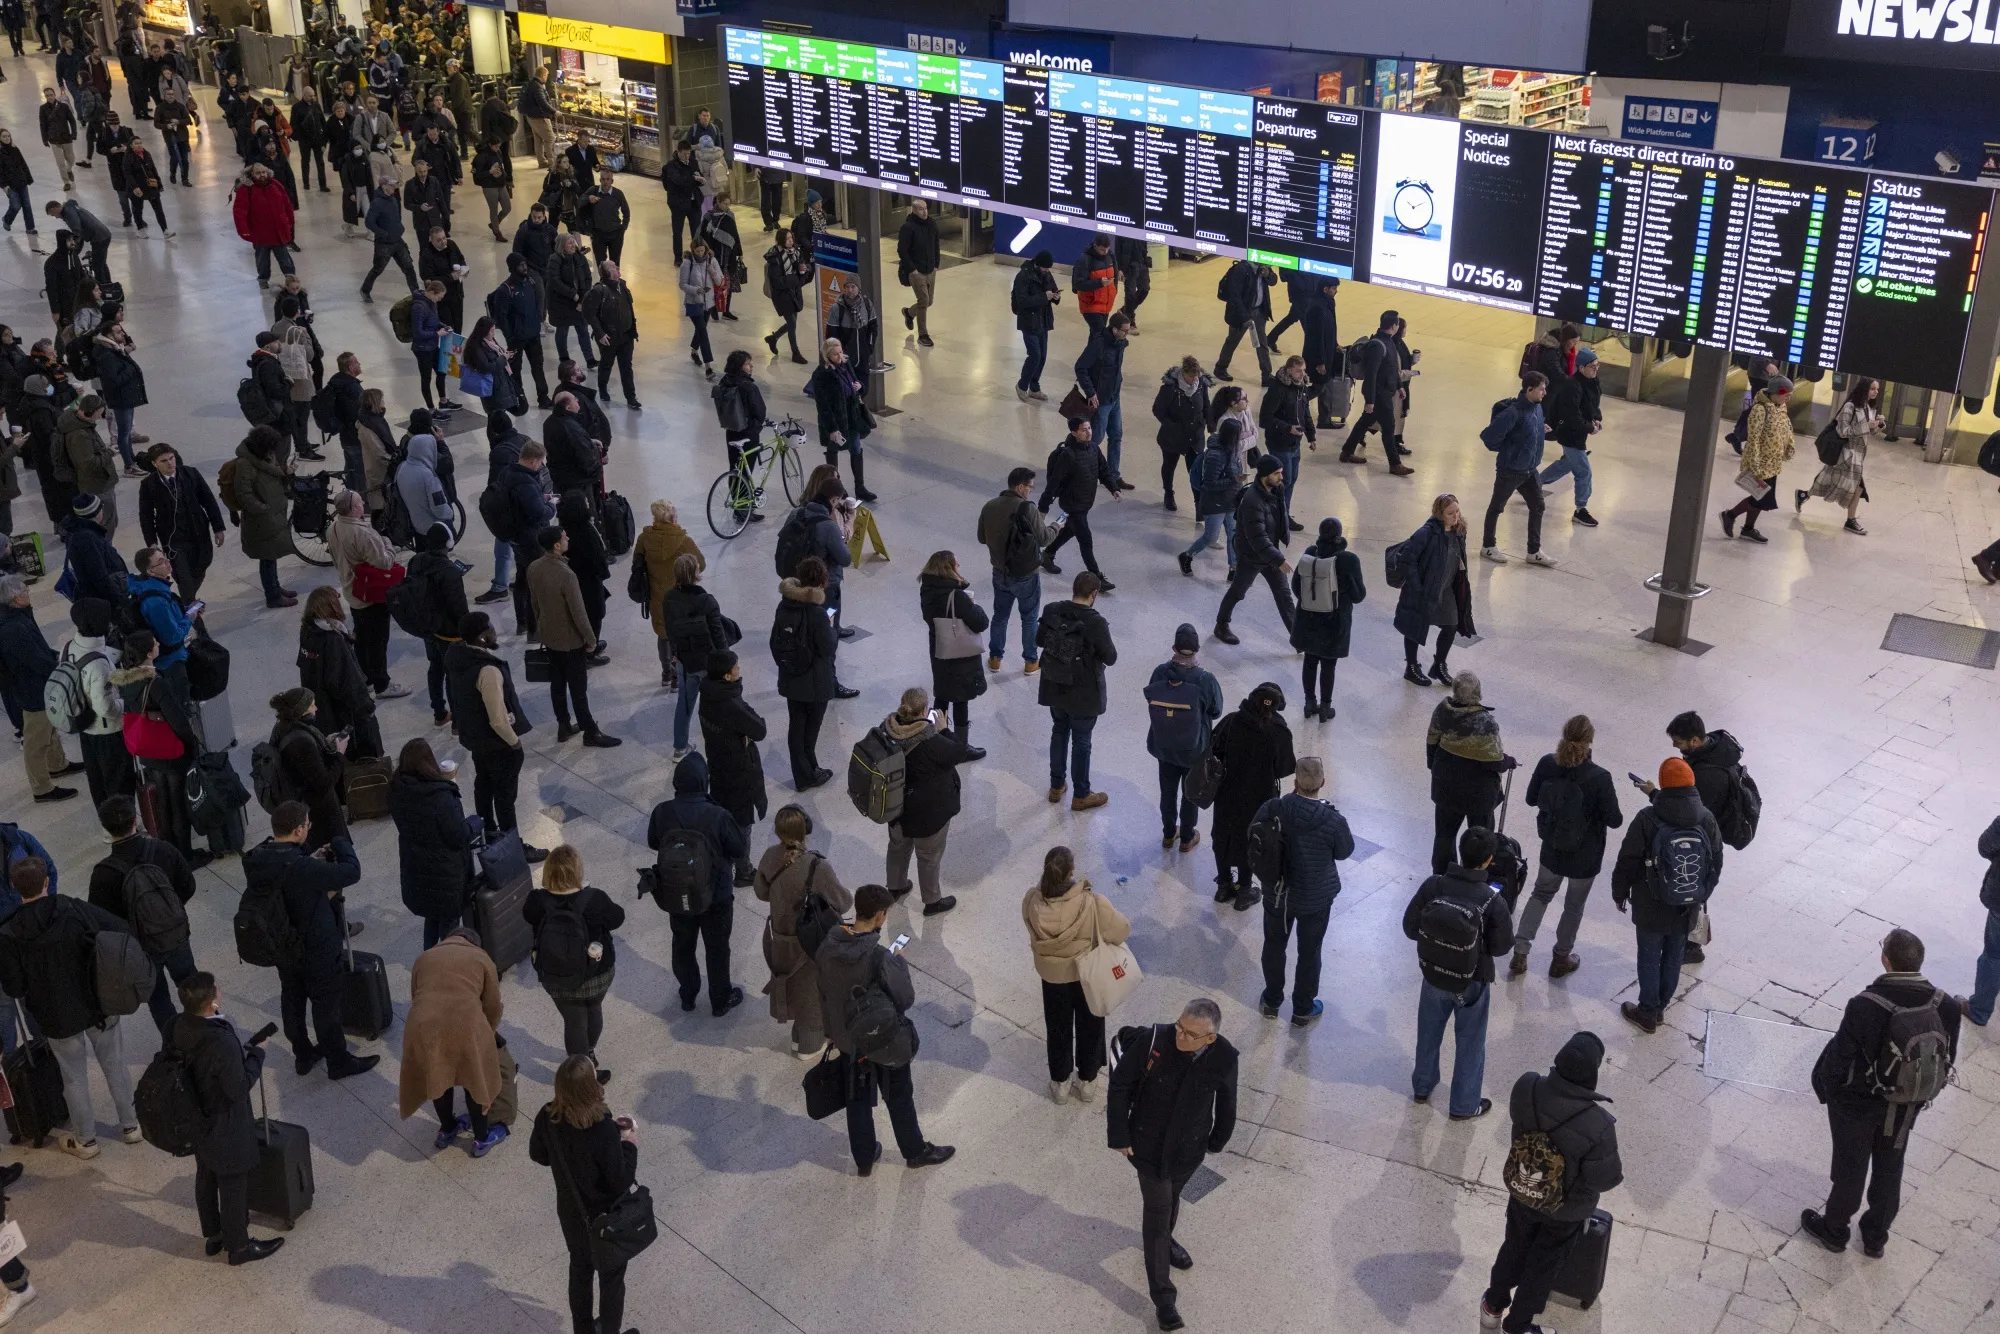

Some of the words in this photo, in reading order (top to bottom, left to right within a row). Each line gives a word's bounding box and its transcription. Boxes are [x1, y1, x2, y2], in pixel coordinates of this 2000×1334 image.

[1837, 0, 2000, 44] NEWSL
[546, 19, 570, 42] Upper
[569, 26, 593, 42] Crust
[1010, 49, 1093, 72] welcome
[1026, 70, 1048, 78] Cancelled
[1099, 89, 1132, 101] Strawberry
[1257, 102, 1297, 118] Further
[1257, 120, 1316, 139] Departures
[1628, 126, 1645, 134] Wide
[1646, 128, 1674, 137] Platform
[1465, 130, 1509, 147] Special
[1822, 136, 1858, 161] 12
[1864, 133, 1876, 160] 12
[1464, 148, 1510, 166] Notices
[1554, 152, 1581, 160] Destination
[1555, 136, 1587, 152] Next
[1589, 140, 1635, 158] fastest
[1638, 146, 1678, 164] direct
[1682, 153, 1715, 168] train
[1719, 157, 1734, 170] to
[1553, 160, 1576, 168] Aldershot
[1653, 165, 1682, 174] Destination
[1652, 173, 1679, 183] Godalming
[1758, 179, 1790, 188] Destination
[1872, 179, 1921, 198] Status
[1650, 190, 1673, 198] Hampton
[1758, 187, 1791, 197] Southamptn
[1756, 196, 1792, 205] Southampton
[1549, 208, 1570, 216] Bracknell
[1761, 205, 1789, 214] Margarets
[1890, 201, 1925, 212] Suburban
[1926, 206, 1946, 214] Lines
[1889, 210, 1909, 219] Major
[1909, 213, 1944, 223] Disruption
[1547, 224, 1568, 233] Clapham
[1887, 222, 1908, 230] South
[1909, 224, 1939, 234] Western
[1940, 229, 1972, 239] Mainline
[1886, 230, 1905, 239] Major
[1906, 233, 1940, 244] Disruption
[1644, 239, 1665, 247] Kingston
[1750, 238, 1780, 247] Teddington
[824, 242, 852, 254] Information
[1749, 247, 1782, 256] Twickenham
[1883, 242, 1926, 253] Portsmouth
[1927, 248, 1950, 257] Direct
[1654, 257, 1672, 265] Malden
[1748, 255, 1770, 263] Vauxhall
[1882, 250, 1901, 259] Major
[1902, 253, 1937, 264] Disruption
[1641, 263, 1663, 271] Norbiton
[1775, 268, 1796, 276] Thames
[1880, 261, 1916, 272] Hounslow
[1916, 267, 1935, 277] Loop
[1452, 263, 1504, 288] 07:56
[1506, 278, 1522, 292] 20
[1640, 271, 1666, 280] Petersfield
[1745, 272, 1778, 282] Wandsworth
[1879, 270, 1898, 278] Minor
[1899, 273, 1933, 284] Disruption
[1541, 278, 1570, 288] Farnborough
[1876, 280, 1889, 288] All
[1889, 283, 1914, 292] other
[1915, 286, 1936, 296] lines
[1638, 287, 1666, 296] Portsmouth
[1743, 289, 1771, 298] Weybridge
[1875, 290, 1893, 298] Good
[1894, 294, 1917, 302] service
[1741, 305, 1770, 314] Wimbledon
[1739, 313, 1769, 322] Winchester
[1634, 319, 1658, 328] Richmond
[1738, 321, 1760, 329] Windsor
[1633, 327, 1656, 336] Salisbury
[1737, 329, 1756, 338] Woking
[1736, 338, 1766, 347] Wokingham
[1735, 346, 1761, 354] Worcester
[1511, 1180, 1544, 1199] adidas
